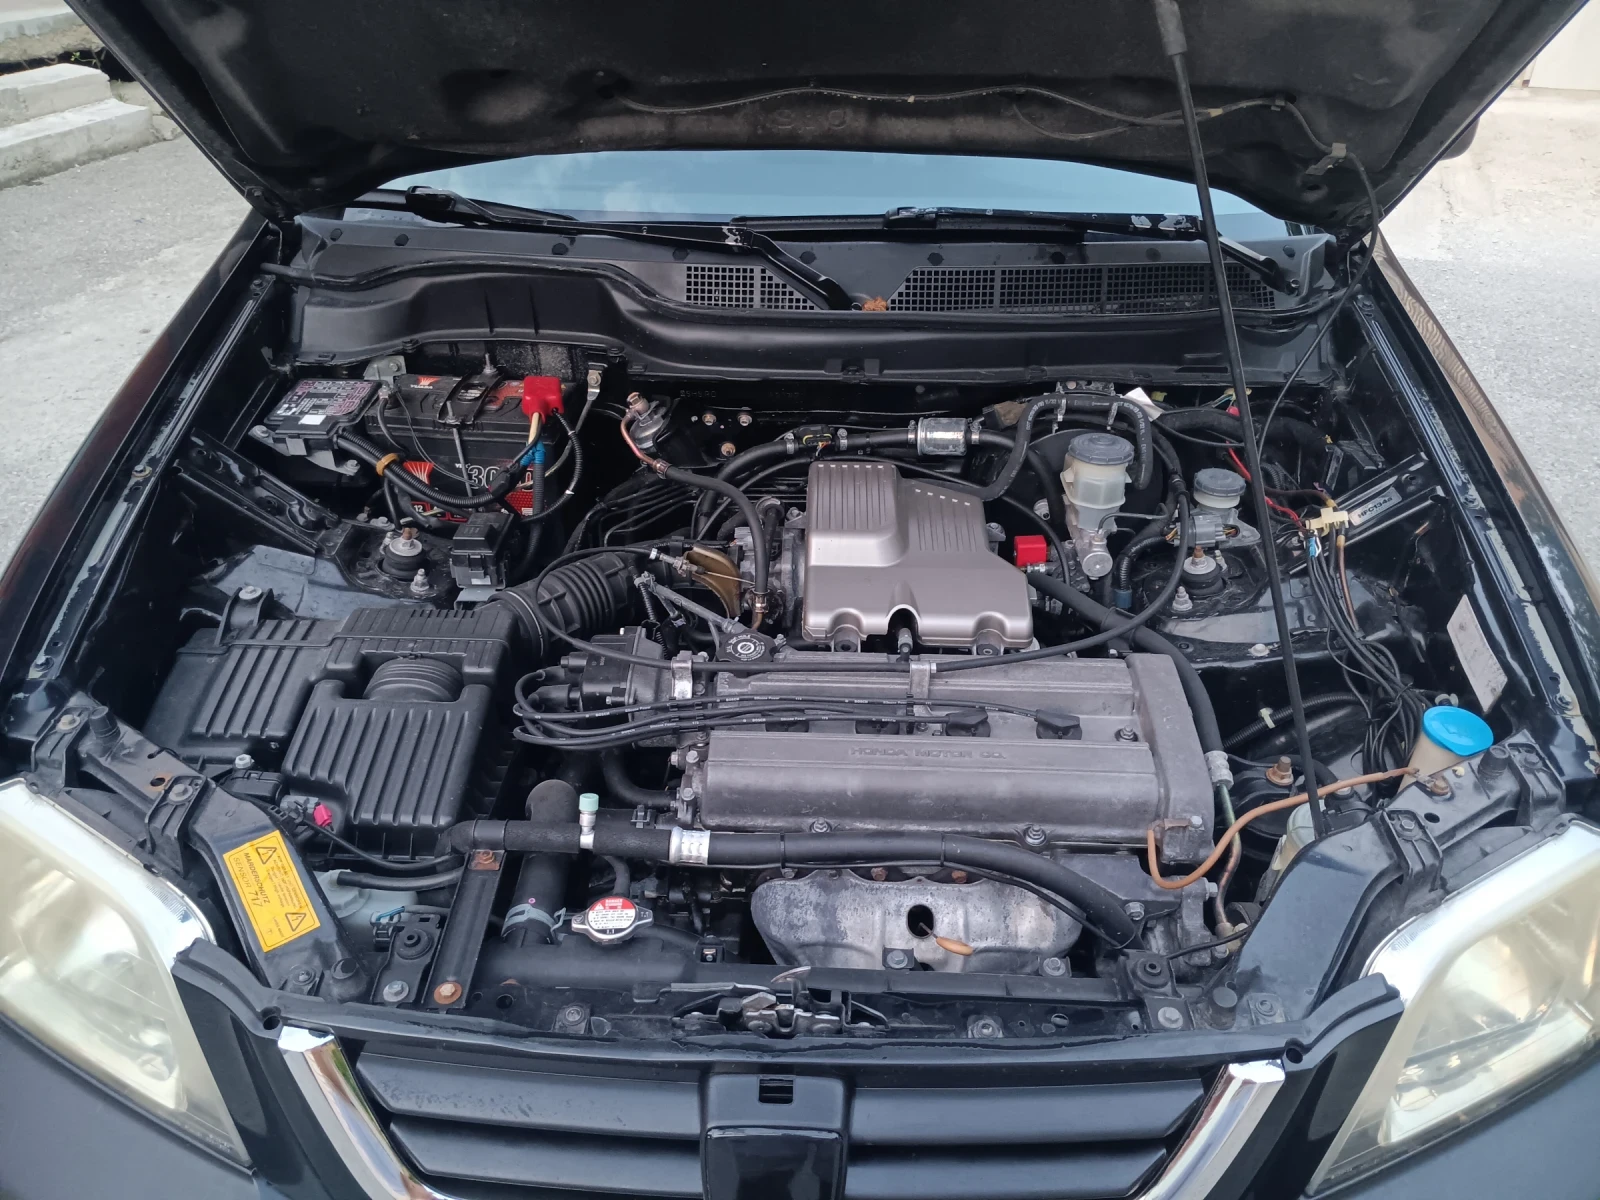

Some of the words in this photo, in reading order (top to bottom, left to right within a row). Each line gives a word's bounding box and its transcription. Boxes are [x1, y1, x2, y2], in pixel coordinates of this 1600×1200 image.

[851, 747, 909, 758] HONDA
[914, 748, 972, 759] MOTOR
[233, 857, 252, 888] SENSOR
[248, 889, 264, 908] 717
[243, 852, 271, 904] MARDERSCHUTZ
